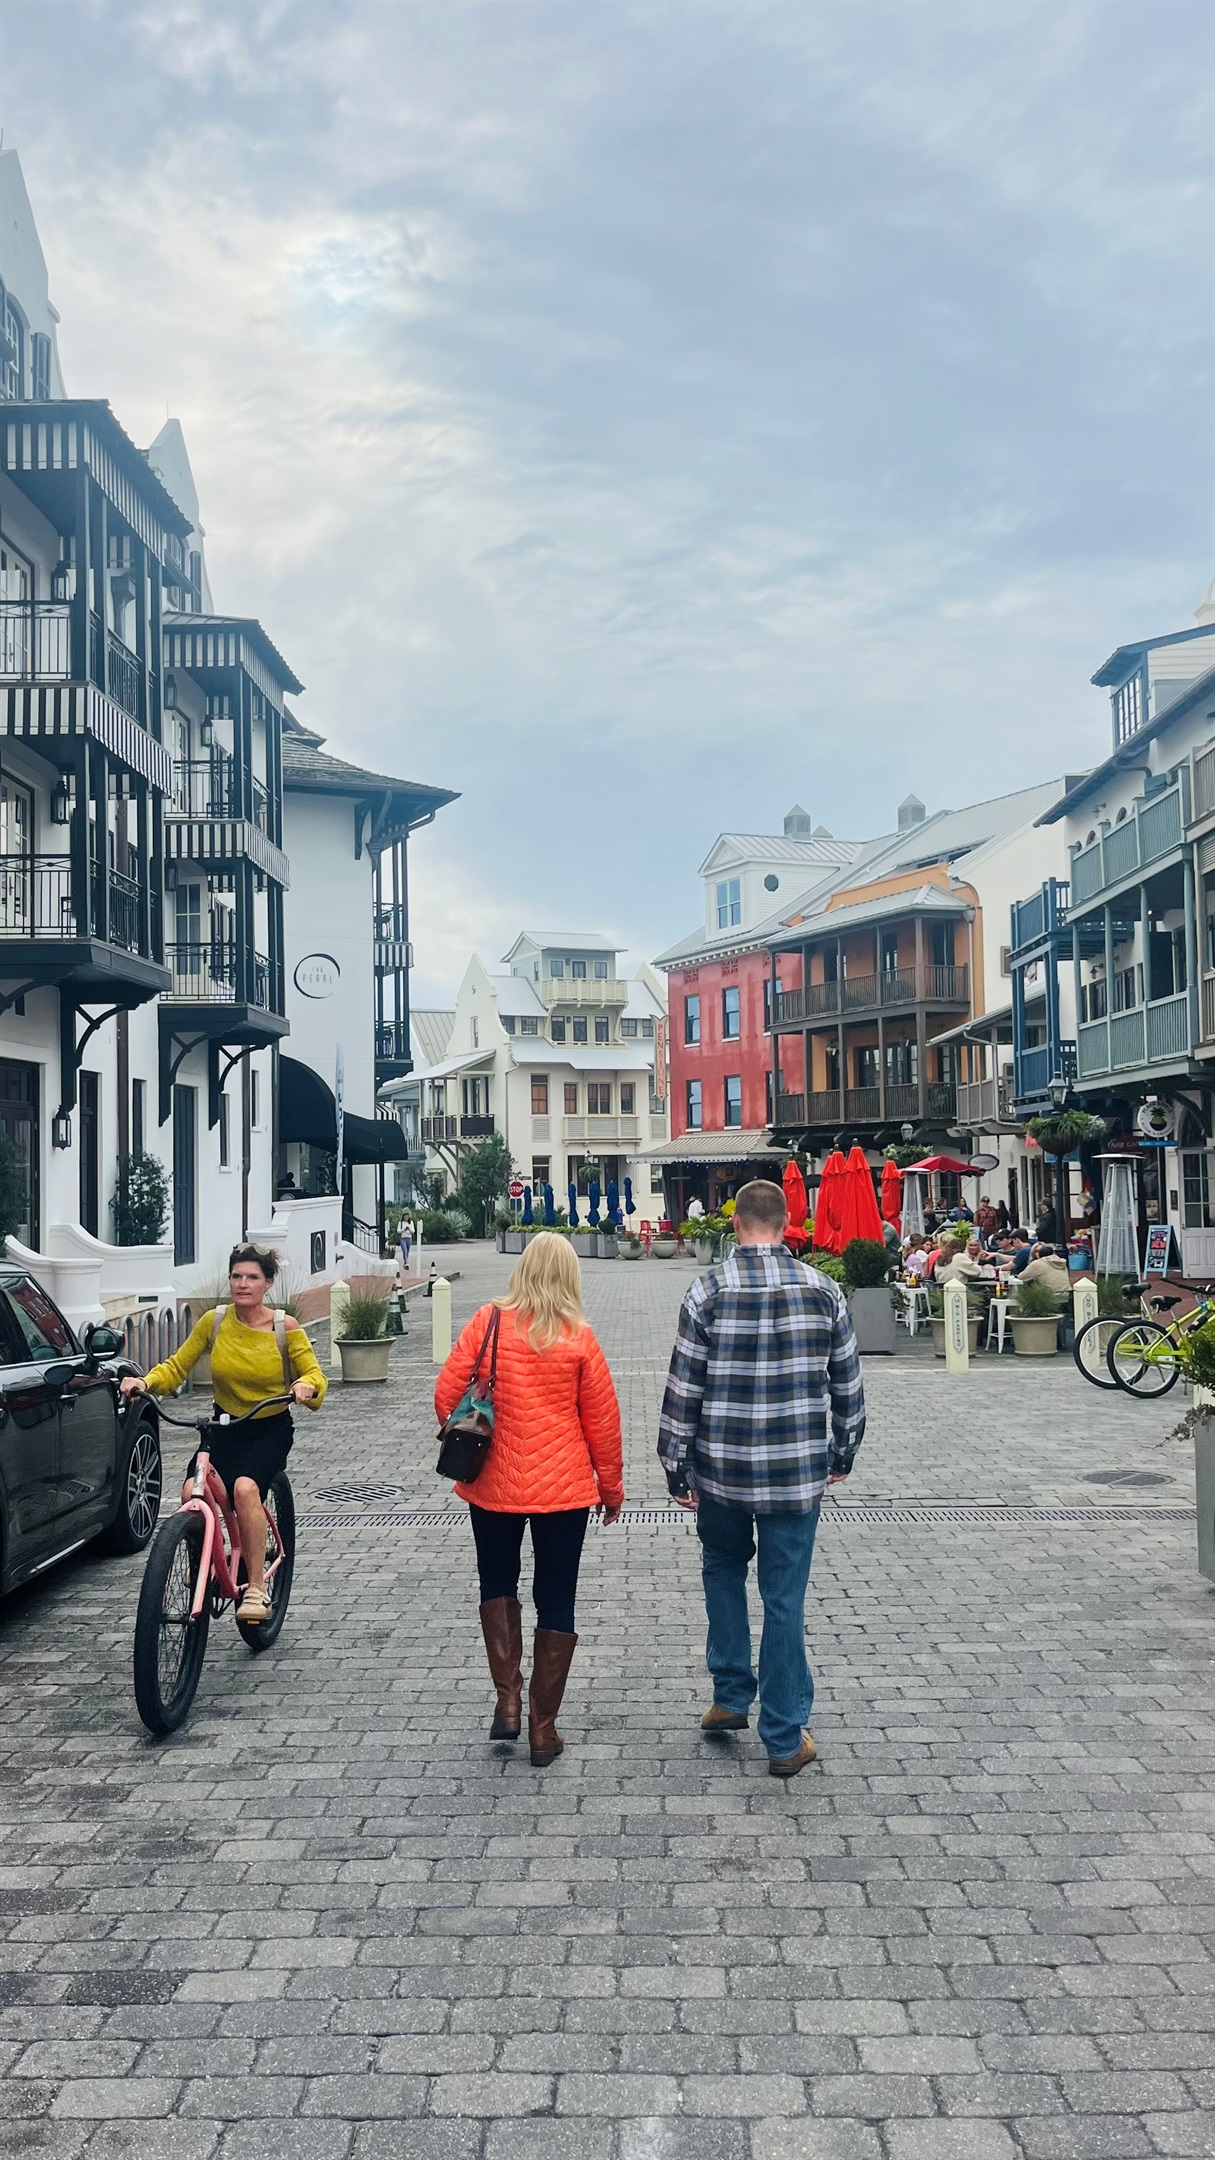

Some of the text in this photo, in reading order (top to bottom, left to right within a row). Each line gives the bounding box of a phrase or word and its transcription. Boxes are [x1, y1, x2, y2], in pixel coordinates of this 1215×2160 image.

[302, 973, 333, 984] PEARL
[657, 1023, 665, 1095] PENSIONE
[510, 1186, 523, 1194] STOP
[1086, 1299, 1091, 1307] NO
